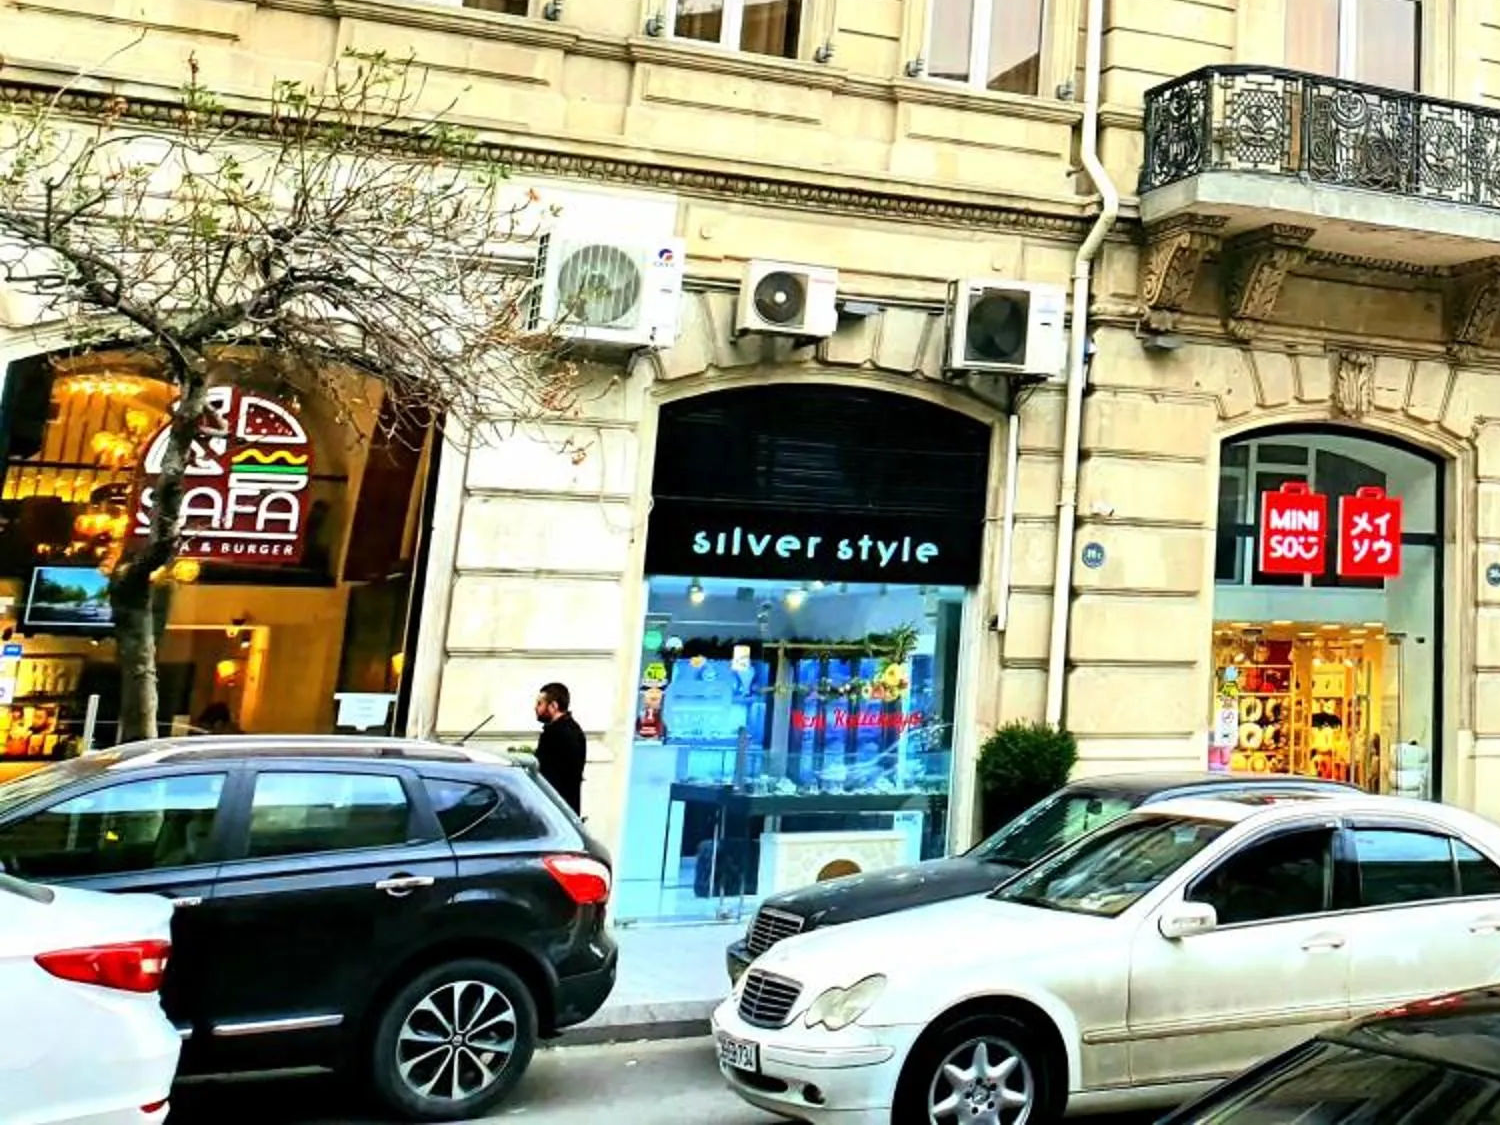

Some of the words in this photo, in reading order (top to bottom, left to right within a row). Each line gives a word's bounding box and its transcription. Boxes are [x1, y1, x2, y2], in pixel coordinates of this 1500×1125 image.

[1270, 508, 1319, 532] MINI
[1350, 512, 1392, 535] メイ
[221, 542, 294, 555] BURGER
[692, 526, 822, 559] silver
[837, 534, 939, 567] style
[1351, 538, 1393, 564] ソウ
